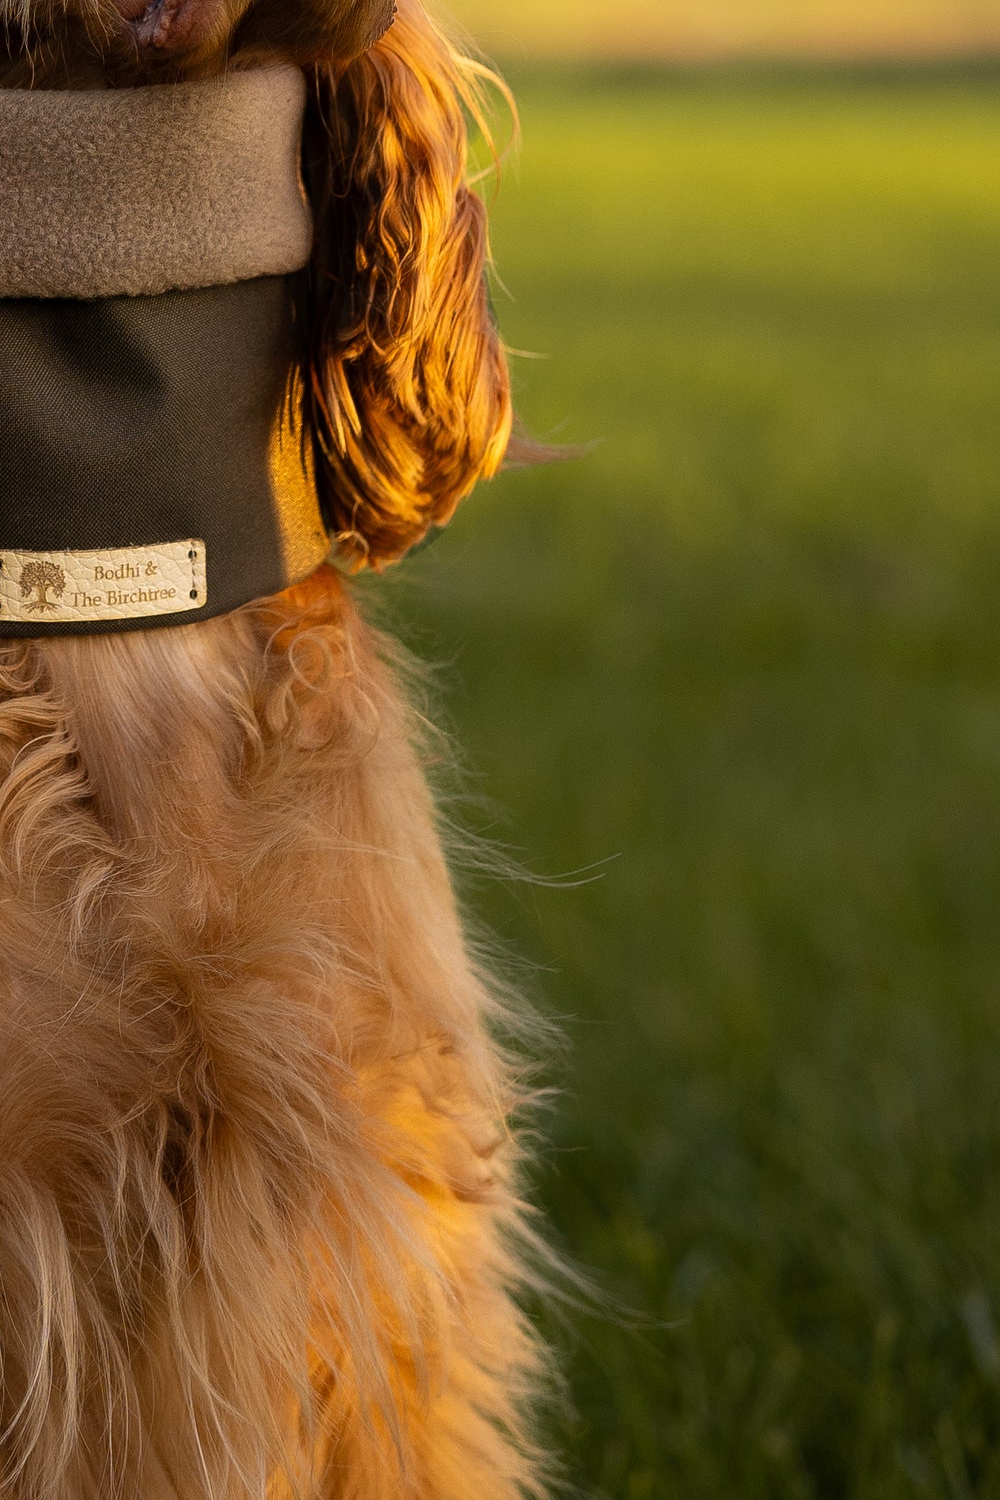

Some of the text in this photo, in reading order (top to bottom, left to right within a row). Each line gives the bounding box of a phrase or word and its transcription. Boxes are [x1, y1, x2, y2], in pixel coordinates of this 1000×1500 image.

[94, 560, 158, 581] Bodhi &
[70, 587, 176, 607] The Birchtree
